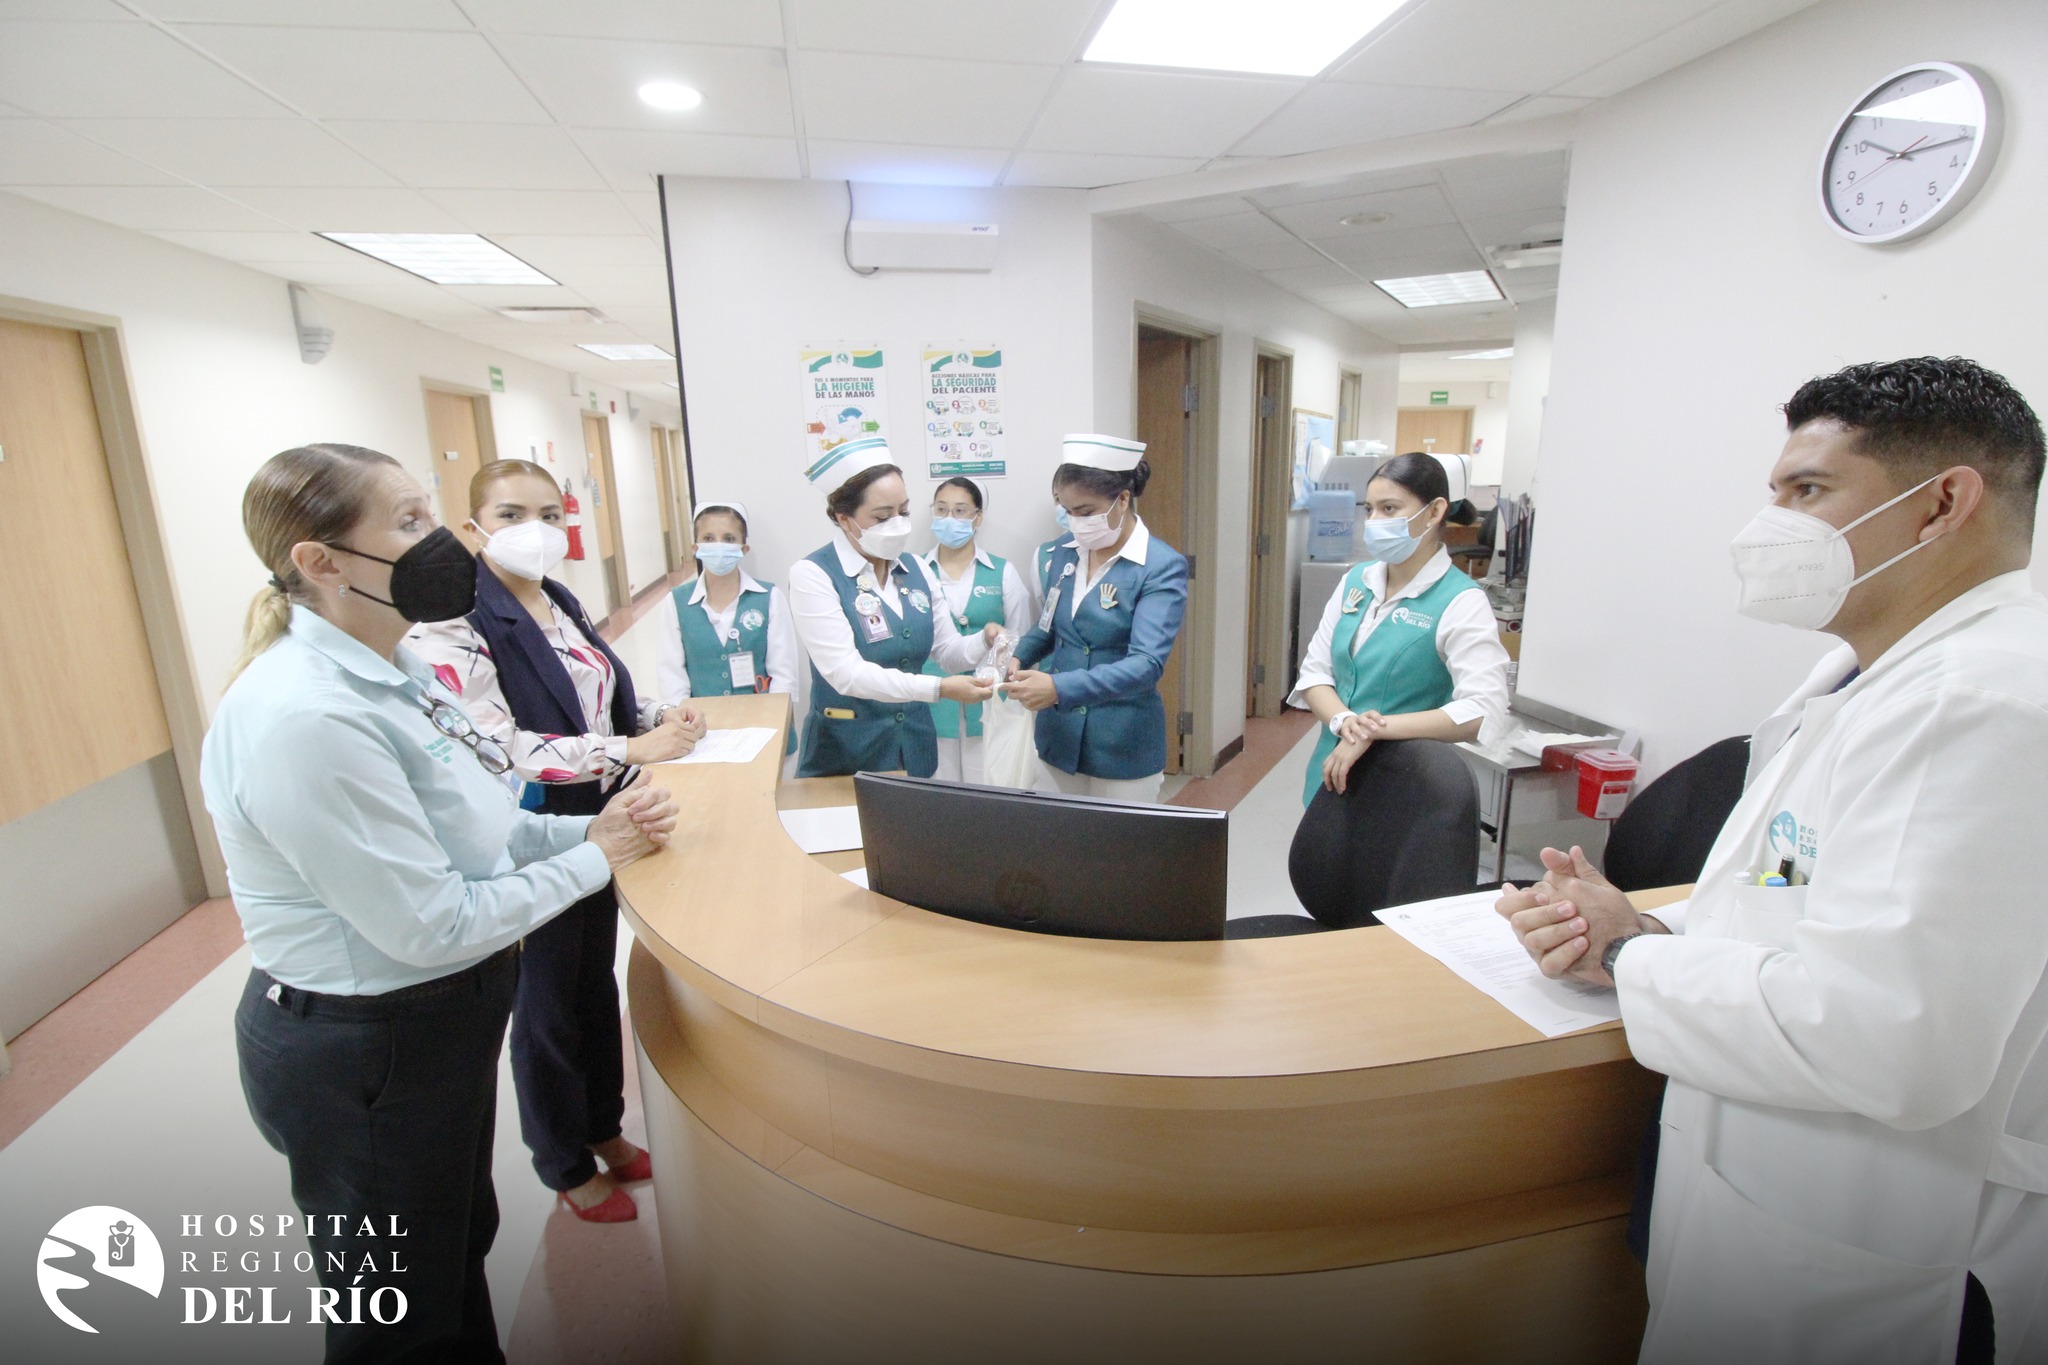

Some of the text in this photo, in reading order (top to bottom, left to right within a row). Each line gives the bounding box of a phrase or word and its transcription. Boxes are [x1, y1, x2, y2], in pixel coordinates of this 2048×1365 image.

[1872, 116, 1884, 130] 11
[1854, 142, 1868, 156] 10
[1949, 154, 1959, 169] 4
[1848, 170, 1856, 184] 9
[1928, 181, 1938, 196] 5
[1856, 192, 1864, 206] 8
[1876, 201, 1884, 216] 7
[1899, 200, 1908, 214] 6
[815, 382, 874, 391] LA HIGIENE
[932, 378, 996, 387] LA SEGURIDAD
[1798, 562, 1824, 571] KN95
